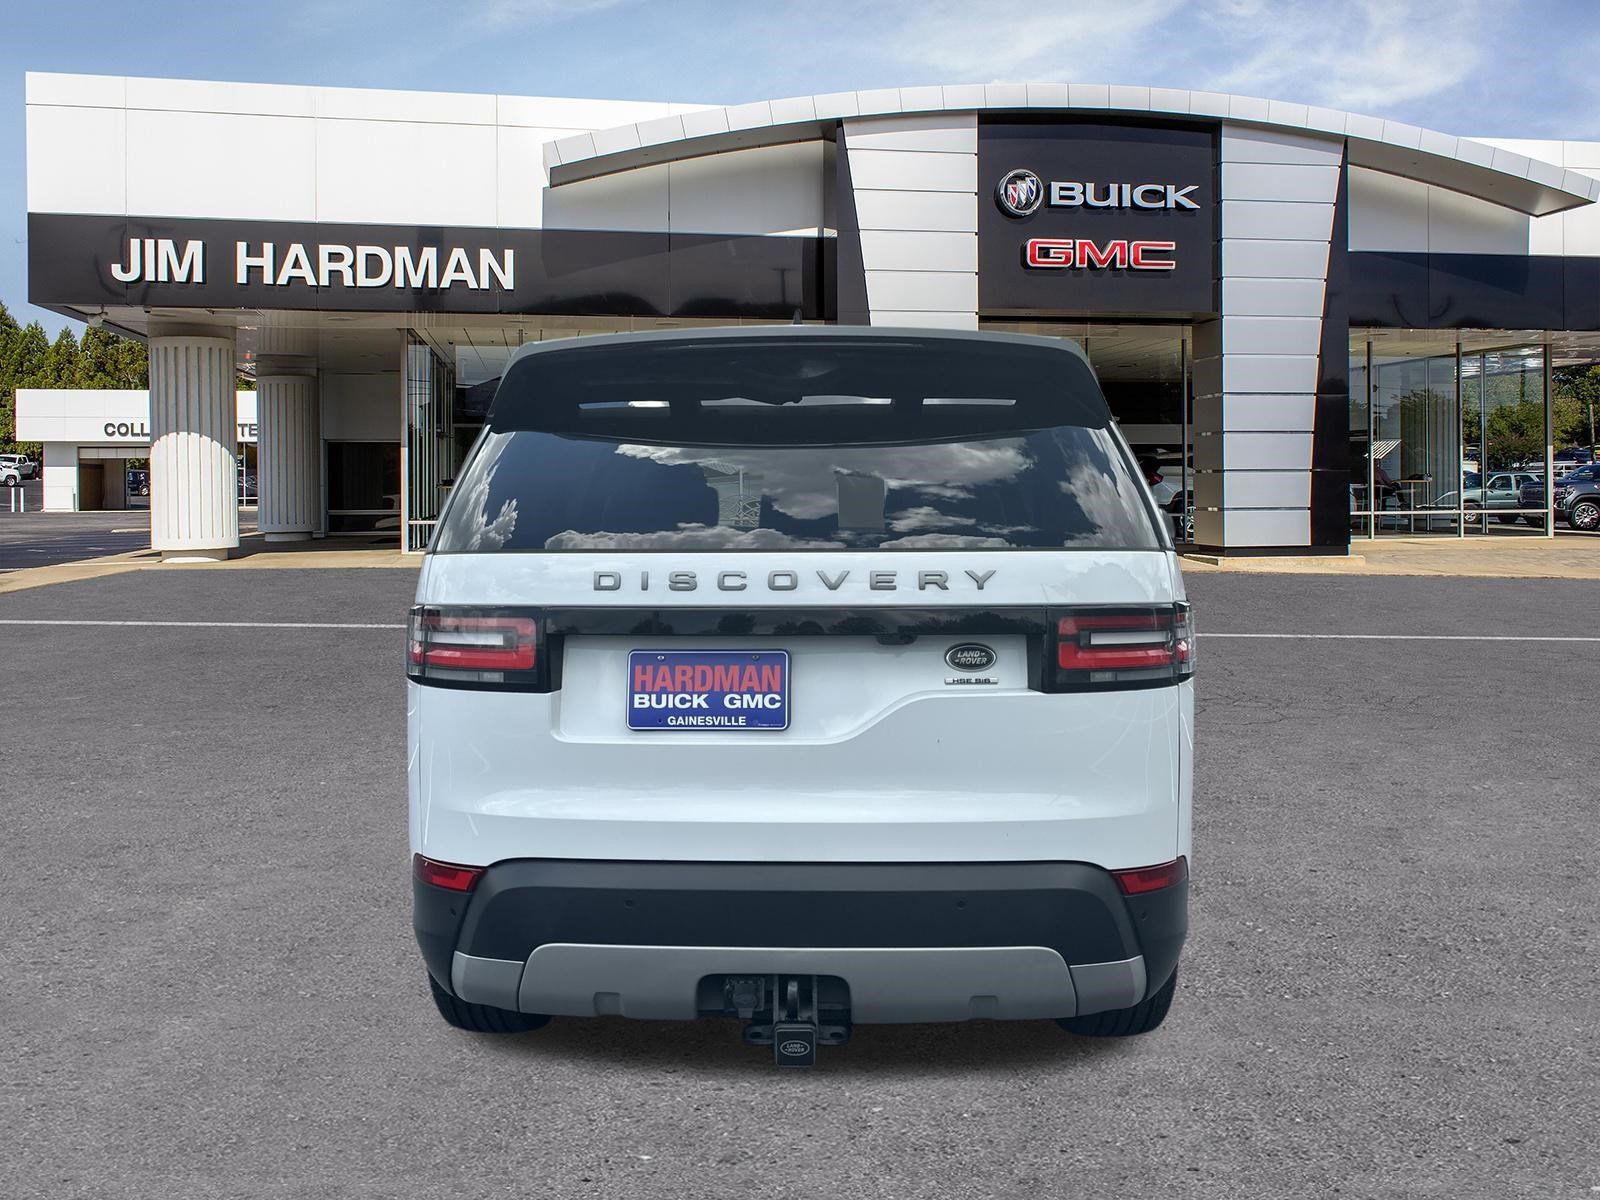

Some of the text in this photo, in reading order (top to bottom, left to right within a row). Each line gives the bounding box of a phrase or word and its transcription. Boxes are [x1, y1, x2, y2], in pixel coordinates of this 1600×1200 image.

[1050, 181, 1200, 209] BUICK
[110, 238, 515, 291] JIM HARDMAN
[1026, 238, 1176, 270] GMC
[593, 570, 997, 591] DISCOVERY
[957, 650, 980, 658] LAND
[959, 657, 988, 665] ROVER
[634, 664, 782, 693] HARDMAN
[633, 693, 782, 709] BUICK GMC
[667, 715, 746, 726] GAINESVILLE
